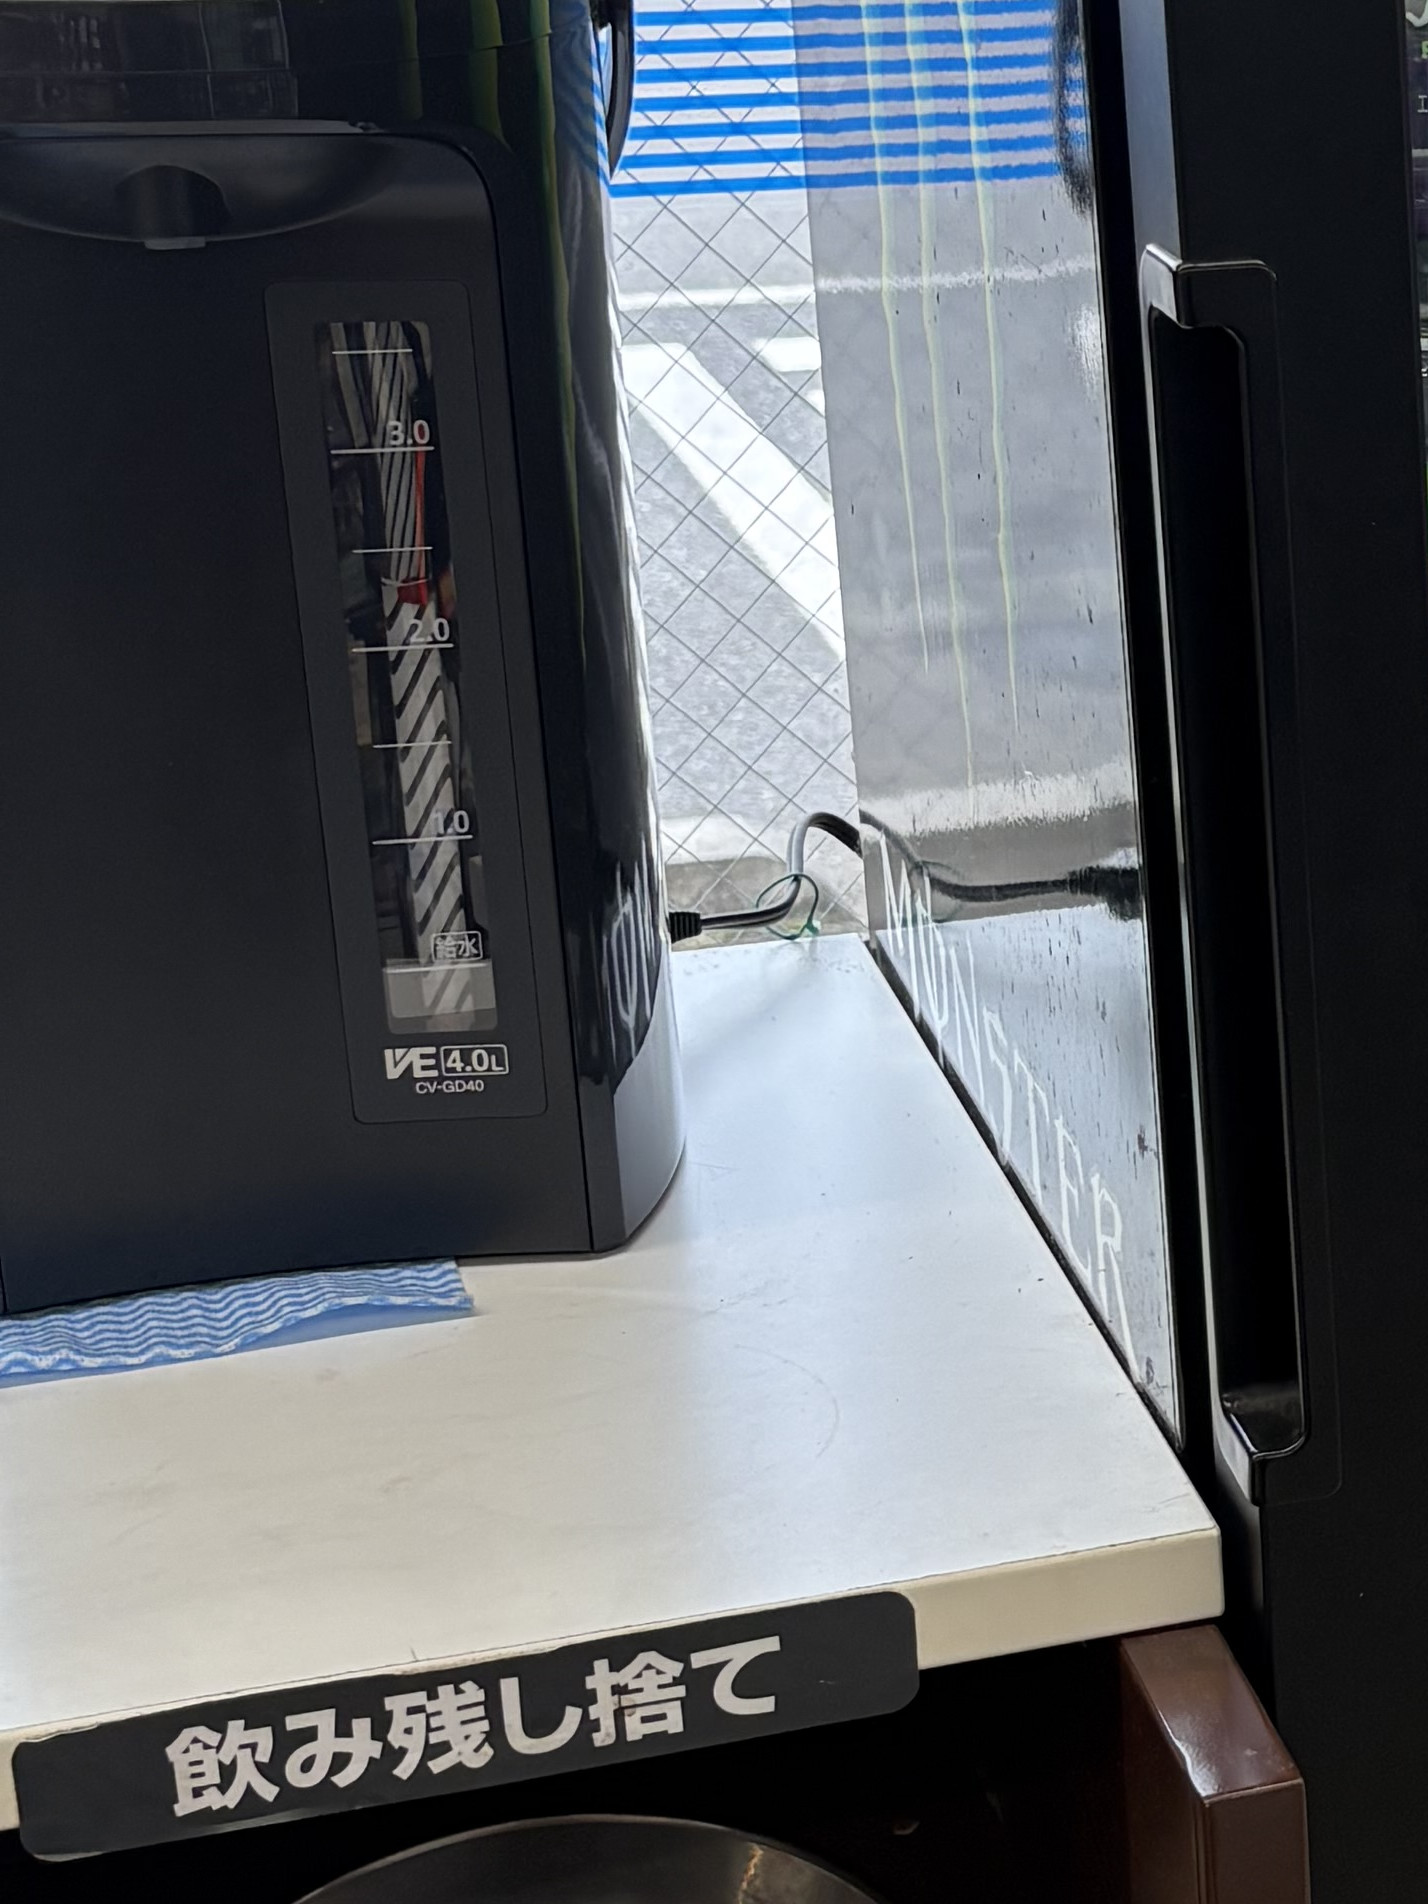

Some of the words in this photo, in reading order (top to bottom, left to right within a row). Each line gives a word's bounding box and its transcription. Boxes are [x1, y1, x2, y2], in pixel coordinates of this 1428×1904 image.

[388, 419, 431, 447] 3.0
[410, 617, 451, 646] 2.0
[432, 809, 471, 835] 1.0
[445, 1047, 505, 1074] 4.0L
[414, 1077, 485, 1095] CV-GD40
[164, 1634, 783, 1819] 飲み残し捨て
